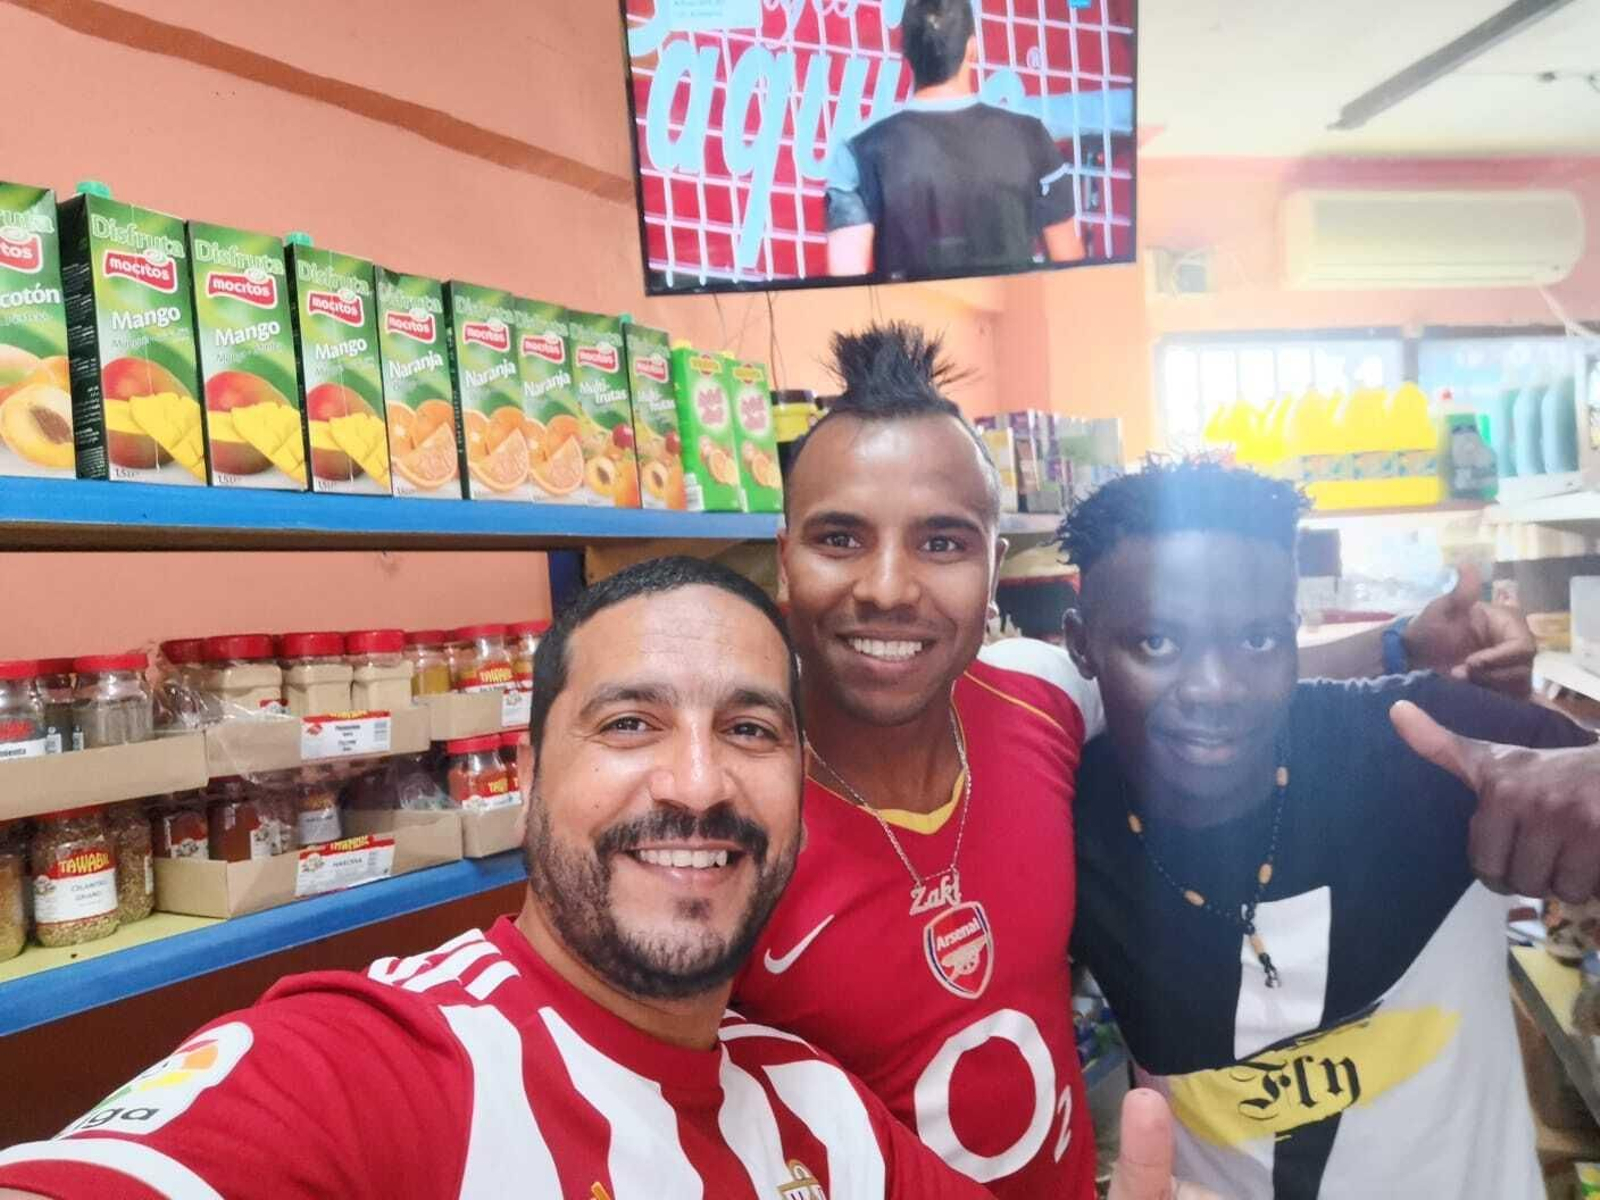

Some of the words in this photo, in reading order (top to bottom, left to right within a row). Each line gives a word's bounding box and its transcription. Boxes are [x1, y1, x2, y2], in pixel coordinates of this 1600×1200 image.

[91, 213, 185, 258] Disfruta
[109, 257, 170, 281] mocitos
[0, 283, 62, 309] cotón
[213, 278, 271, 298] mocitos
[112, 306, 182, 331] Mango
[312, 297, 358, 317] mocitos
[215, 321, 281, 347] Mango
[316, 338, 368, 361] Mango
[389, 350, 444, 380] Naranja
[466, 358, 517, 389] Naranja
[523, 369, 572, 397] Naranja
[936, 917, 981, 953] Arsenal
